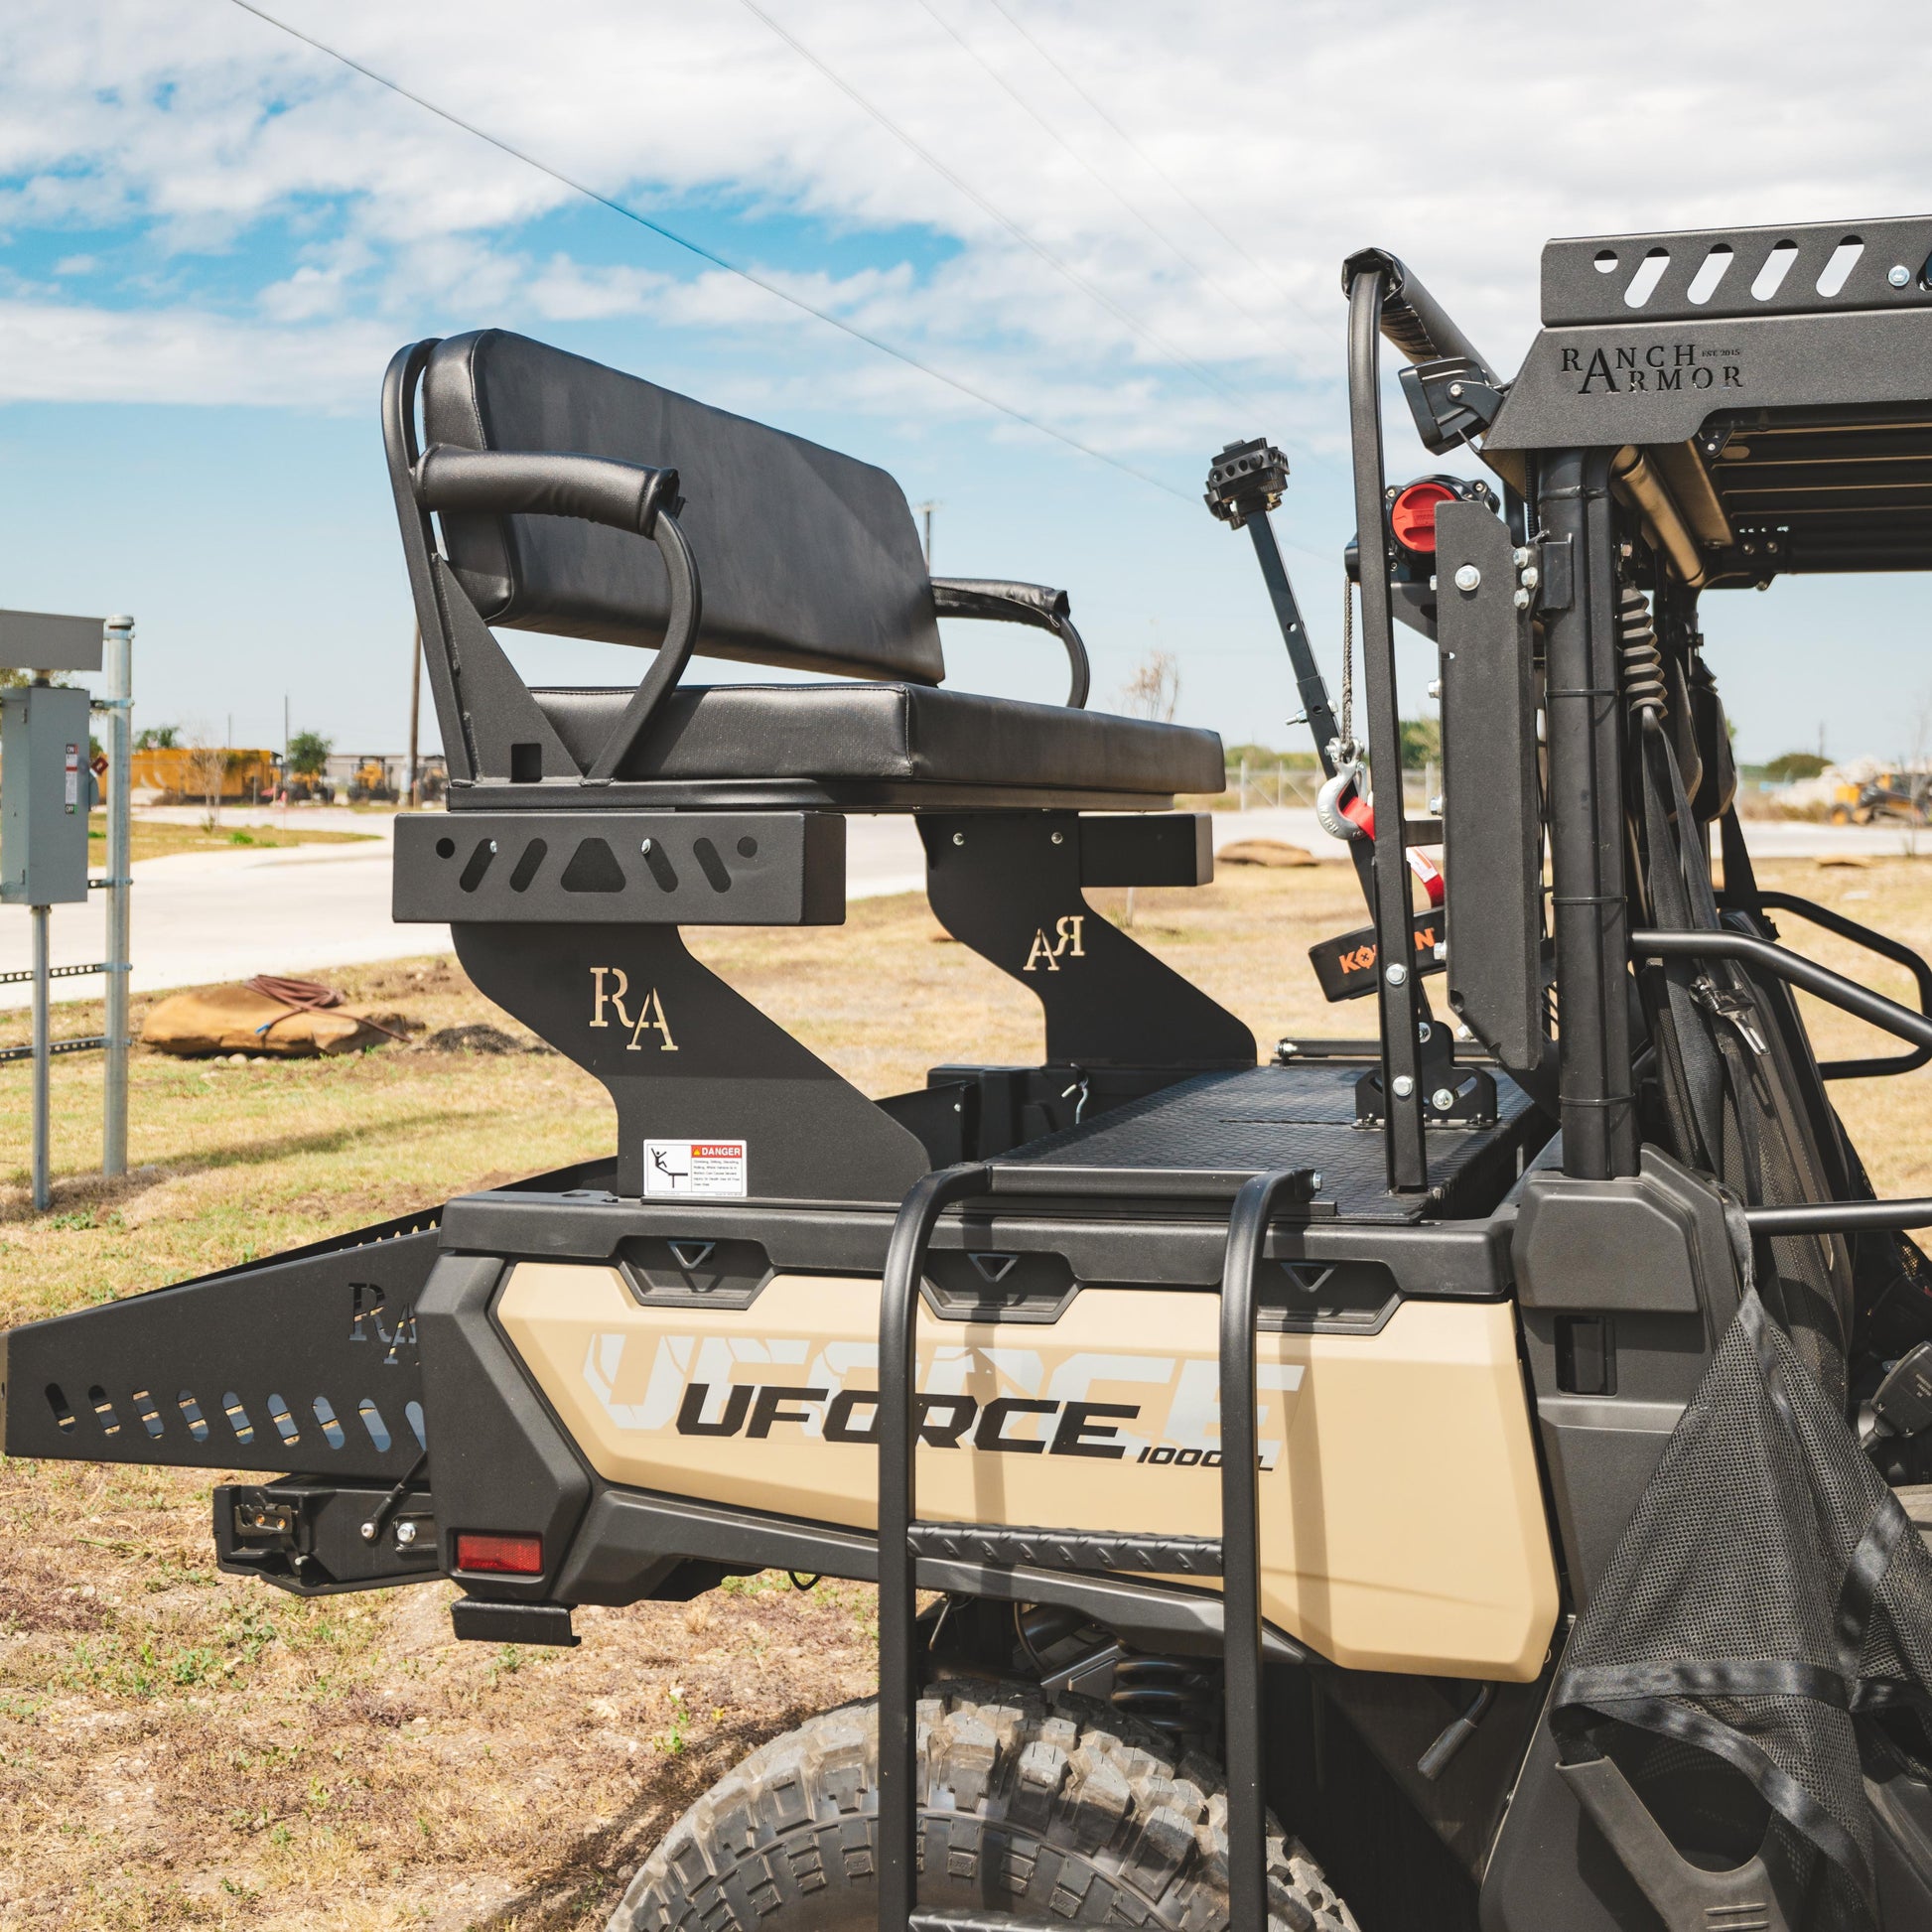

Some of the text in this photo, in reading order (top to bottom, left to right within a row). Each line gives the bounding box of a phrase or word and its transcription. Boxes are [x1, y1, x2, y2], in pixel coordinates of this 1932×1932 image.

[1561, 344, 1696, 394] RANCH
[589, 967, 679, 1050] RA
[701, 1147, 741, 1156] DANGER
[676, 1382, 1141, 1459] UFORCE
